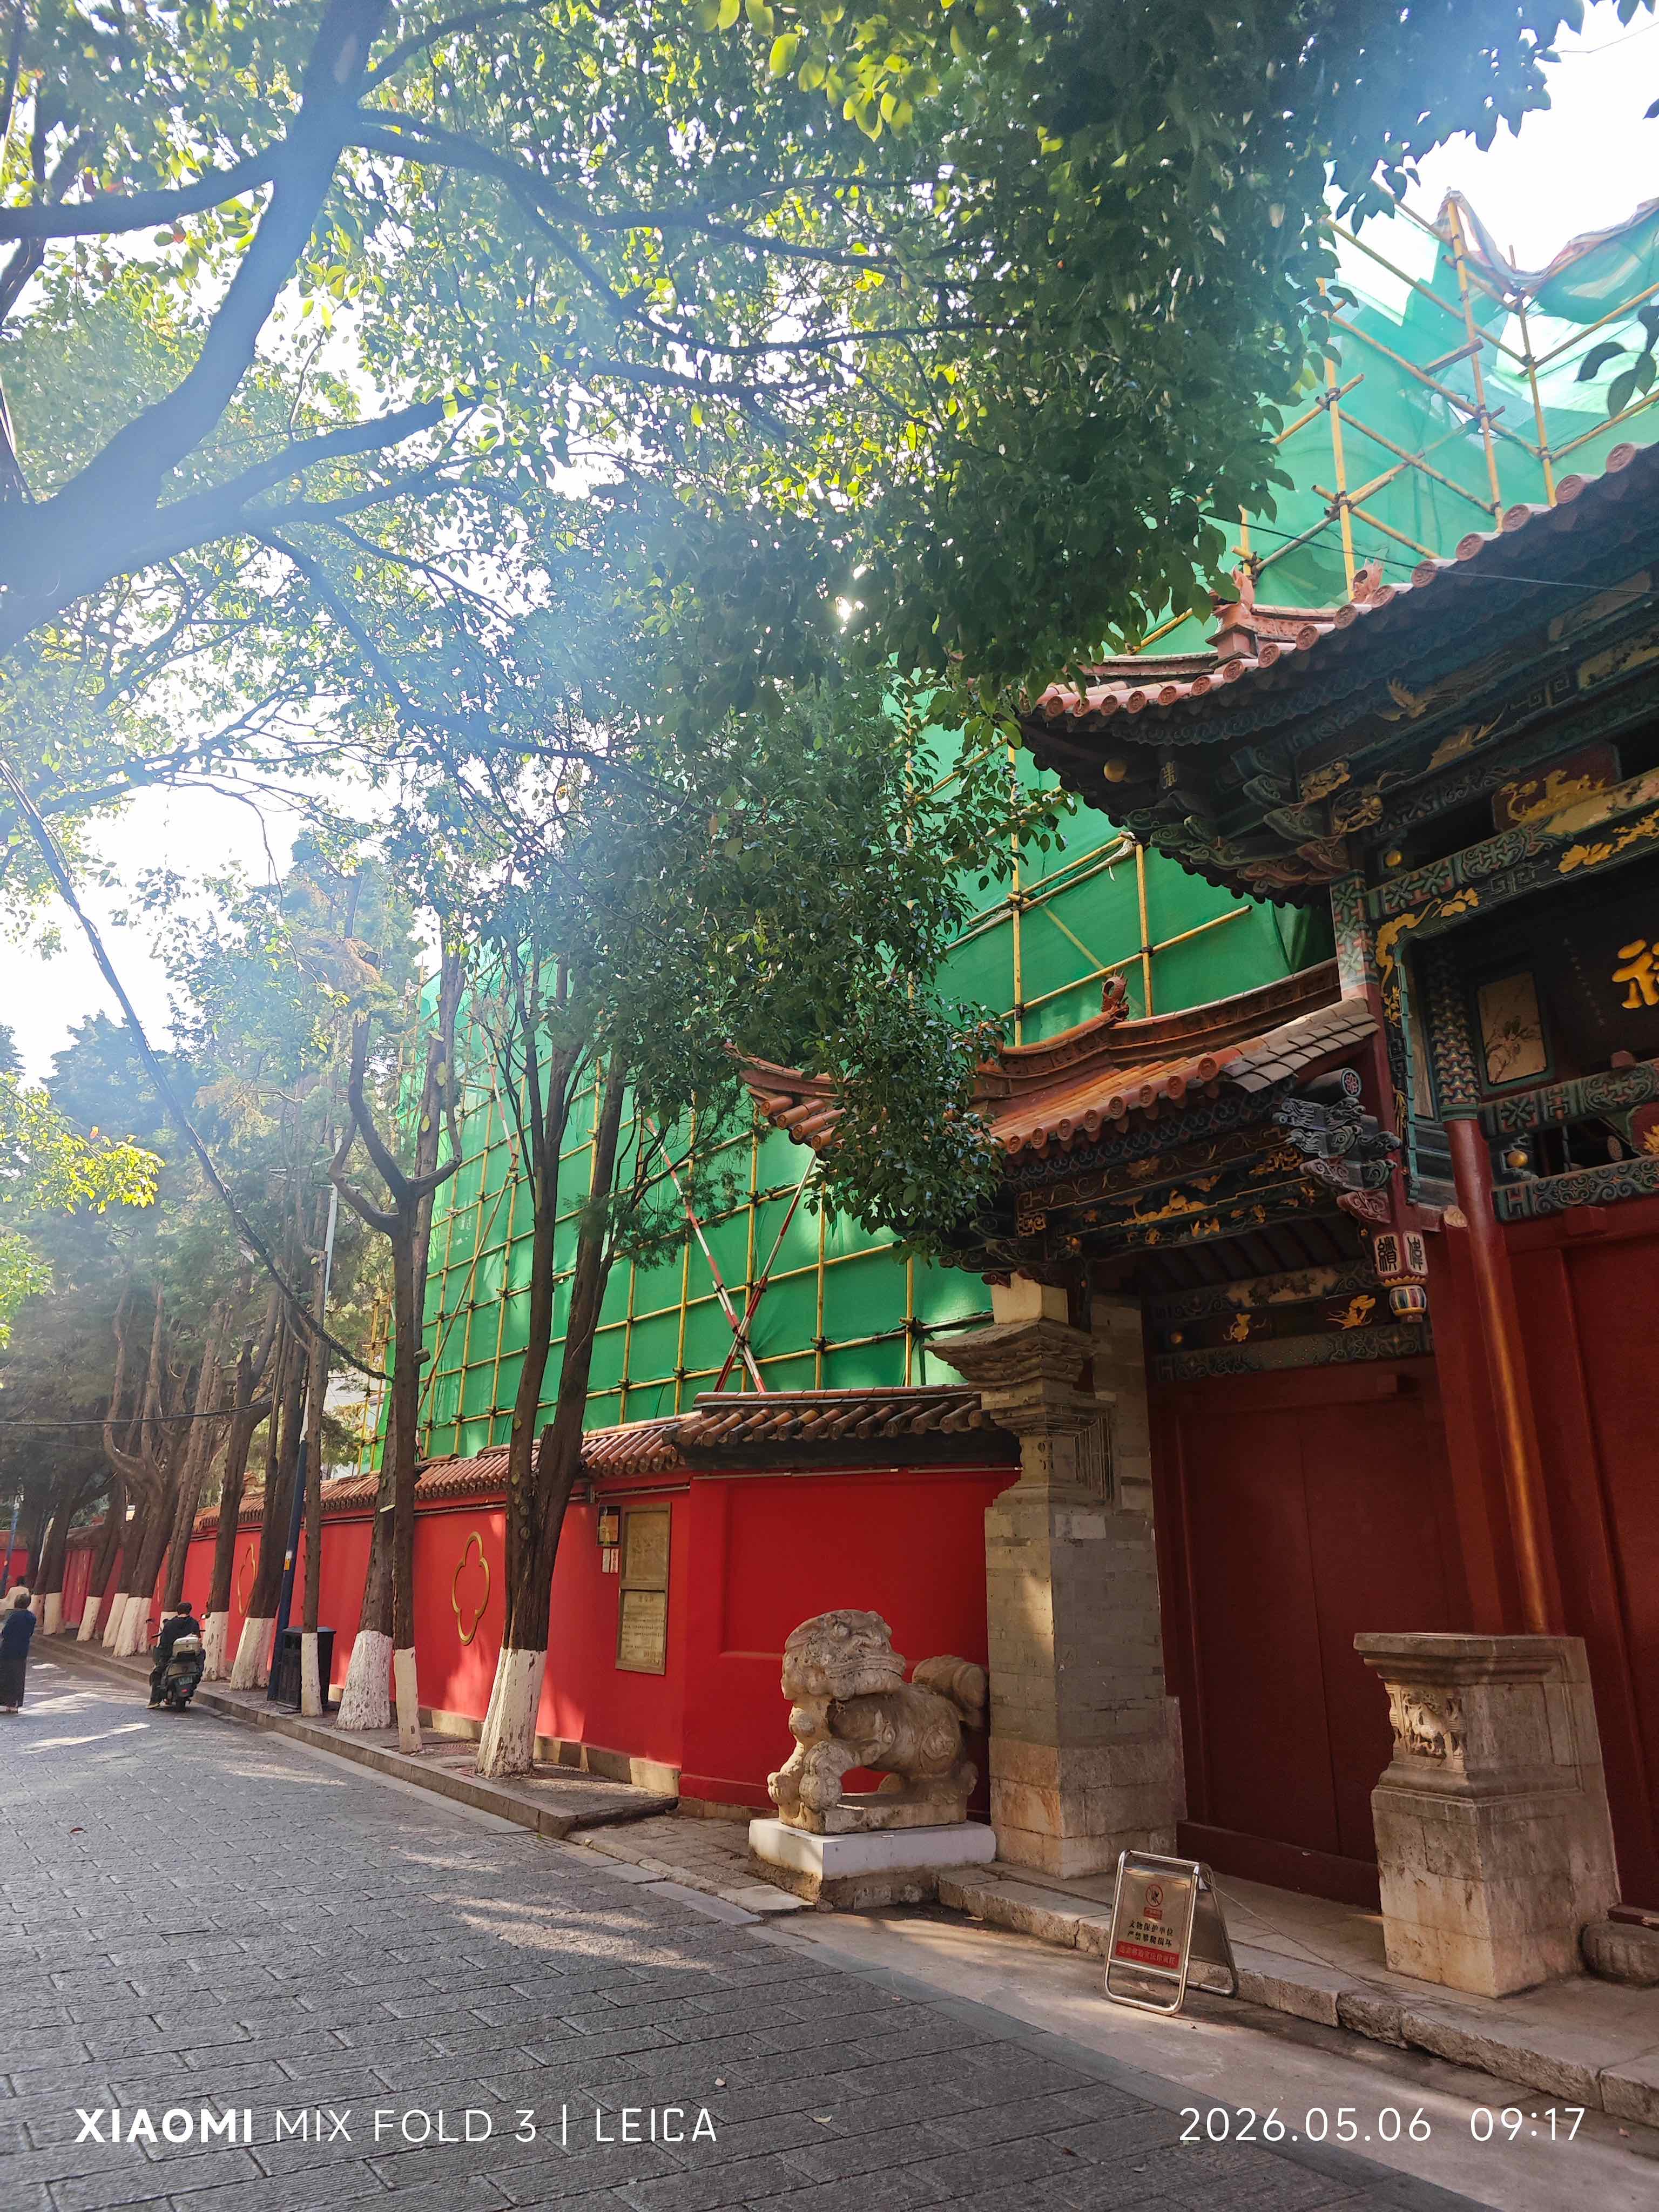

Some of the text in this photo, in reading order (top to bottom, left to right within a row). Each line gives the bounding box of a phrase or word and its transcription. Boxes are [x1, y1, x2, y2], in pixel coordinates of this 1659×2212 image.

[1129, 1920, 1174, 1937] 文物保护单位
